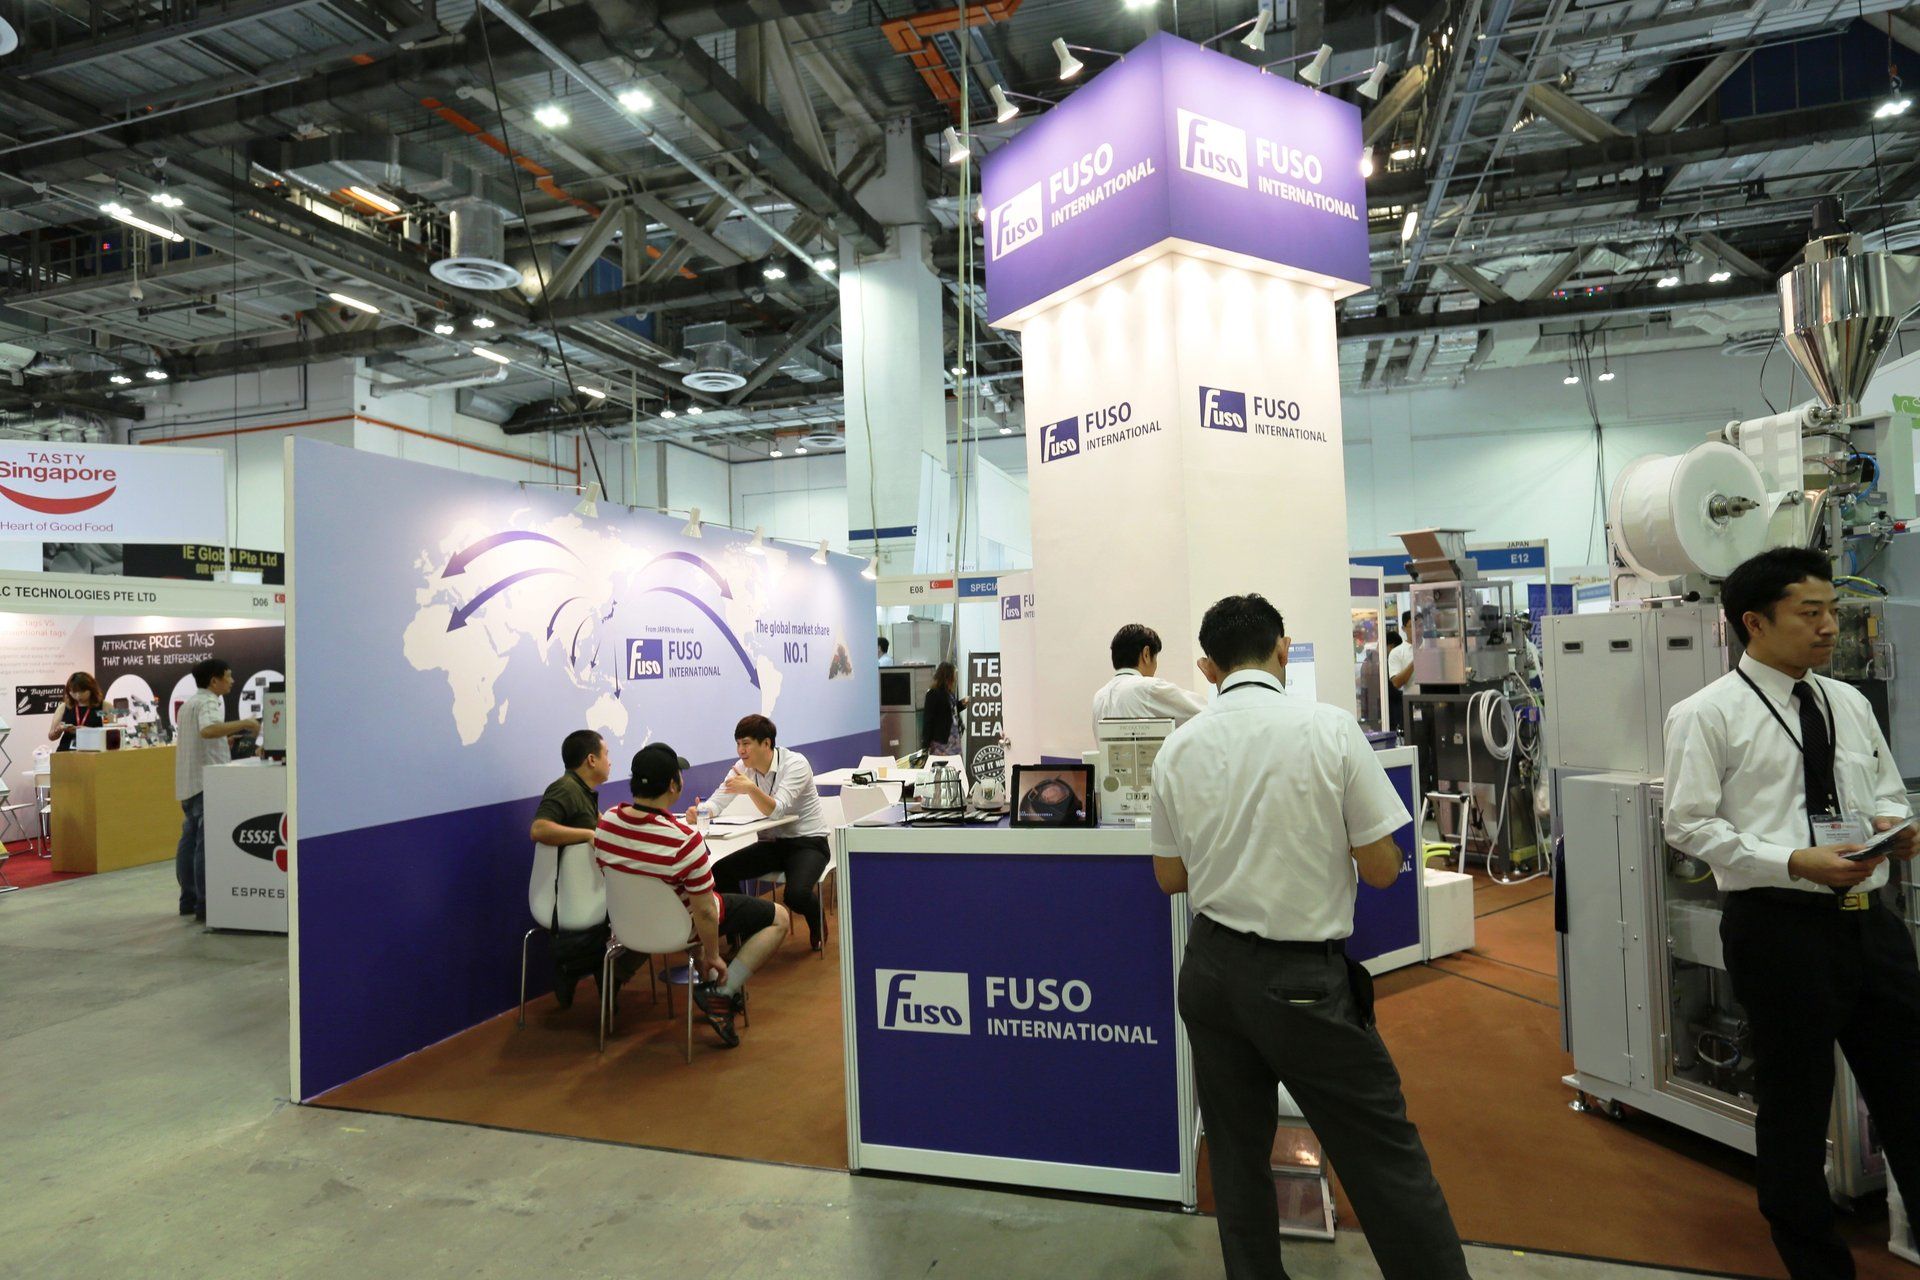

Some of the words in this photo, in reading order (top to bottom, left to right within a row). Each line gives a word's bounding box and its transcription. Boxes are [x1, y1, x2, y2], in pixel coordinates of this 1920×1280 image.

[1257, 137, 1322, 185] FUSO
[1049, 142, 1113, 204] FUSO
[1051, 157, 1155, 228] INTERNATIONAL
[1258, 175, 1359, 221] INTERNATIONAL
[1086, 401, 1132, 433] FUSO
[1254, 396, 1300, 421] FUSO
[1086, 420, 1162, 450] INTERNATIONAL
[1255, 423, 1327, 443] INTERNATIONAL
[28, 453, 85, 464] TASTY
[0, 461, 116, 483] Singapore
[0, 522, 33, 531] Heart
[36, 522, 47, 531] of
[49, 522, 82, 531] Good
[84, 523, 113, 532] Food
[183, 545, 195, 559] IE
[239, 551, 258, 565] Pte
[260, 552, 278, 567] Ltd
[1511, 554, 1529, 563] E12
[0, 586, 11, 597] C
[15, 586, 110, 600] TECHNOLOGIES
[113, 591, 134, 601] PTE
[137, 592, 157, 602] LTD
[909, 586, 924, 594] E08
[253, 598, 268, 607] D06
[755, 619, 768, 633] The
[769, 621, 791, 637] global
[791, 622, 813, 636] market
[814, 624, 830, 636] share
[102, 640, 147, 651] ATTRACTIVE
[149, 635, 182, 651] PRICE
[187, 632, 215, 648] TAGS
[669, 641, 703, 660] FUSO
[102, 656, 120, 666] THAT
[123, 655, 144, 666] MAKE
[147, 655, 161, 665] THE
[784, 642, 808, 663] NO.1
[669, 666, 721, 678] INTERNATIONAL
[973, 658, 1001, 677] TE
[30, 687, 64, 697] Baguette
[239, 829, 276, 845] ESSSE
[986, 976, 1092, 1013] FUSO
[988, 1018, 1158, 1044] INTERNATIONAL
